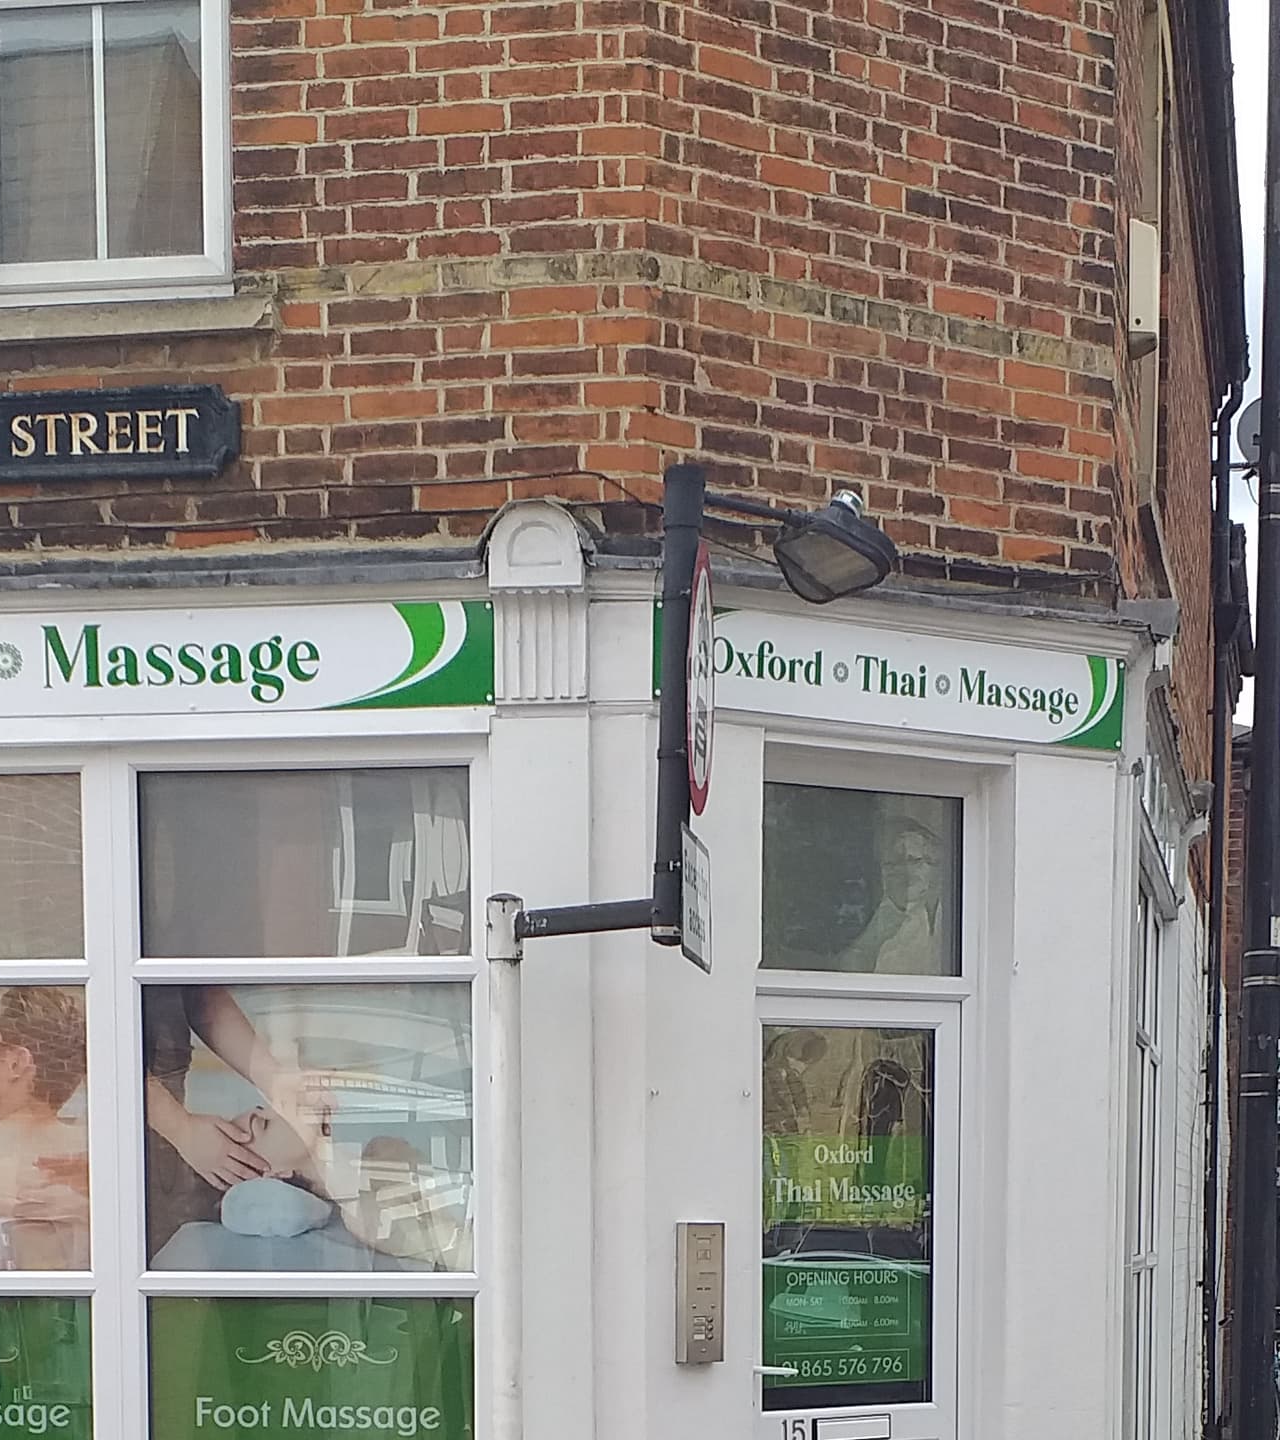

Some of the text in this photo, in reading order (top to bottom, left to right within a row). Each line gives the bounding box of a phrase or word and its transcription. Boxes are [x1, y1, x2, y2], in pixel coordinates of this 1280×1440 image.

[10, 407, 199, 458] STREET
[41, 624, 320, 703] Massage
[713, 637, 1079, 725] Oxford Thai Massage
[814, 1144, 873, 1164] Oxford
[771, 1177, 915, 1208] Thai Massage
[786, 1270, 898, 1287] OPENING HOURS
[838, 1358, 867, 1376] 576
[872, 1356, 903, 1373] 796
[196, 1397, 440, 1436] Foot Massage
